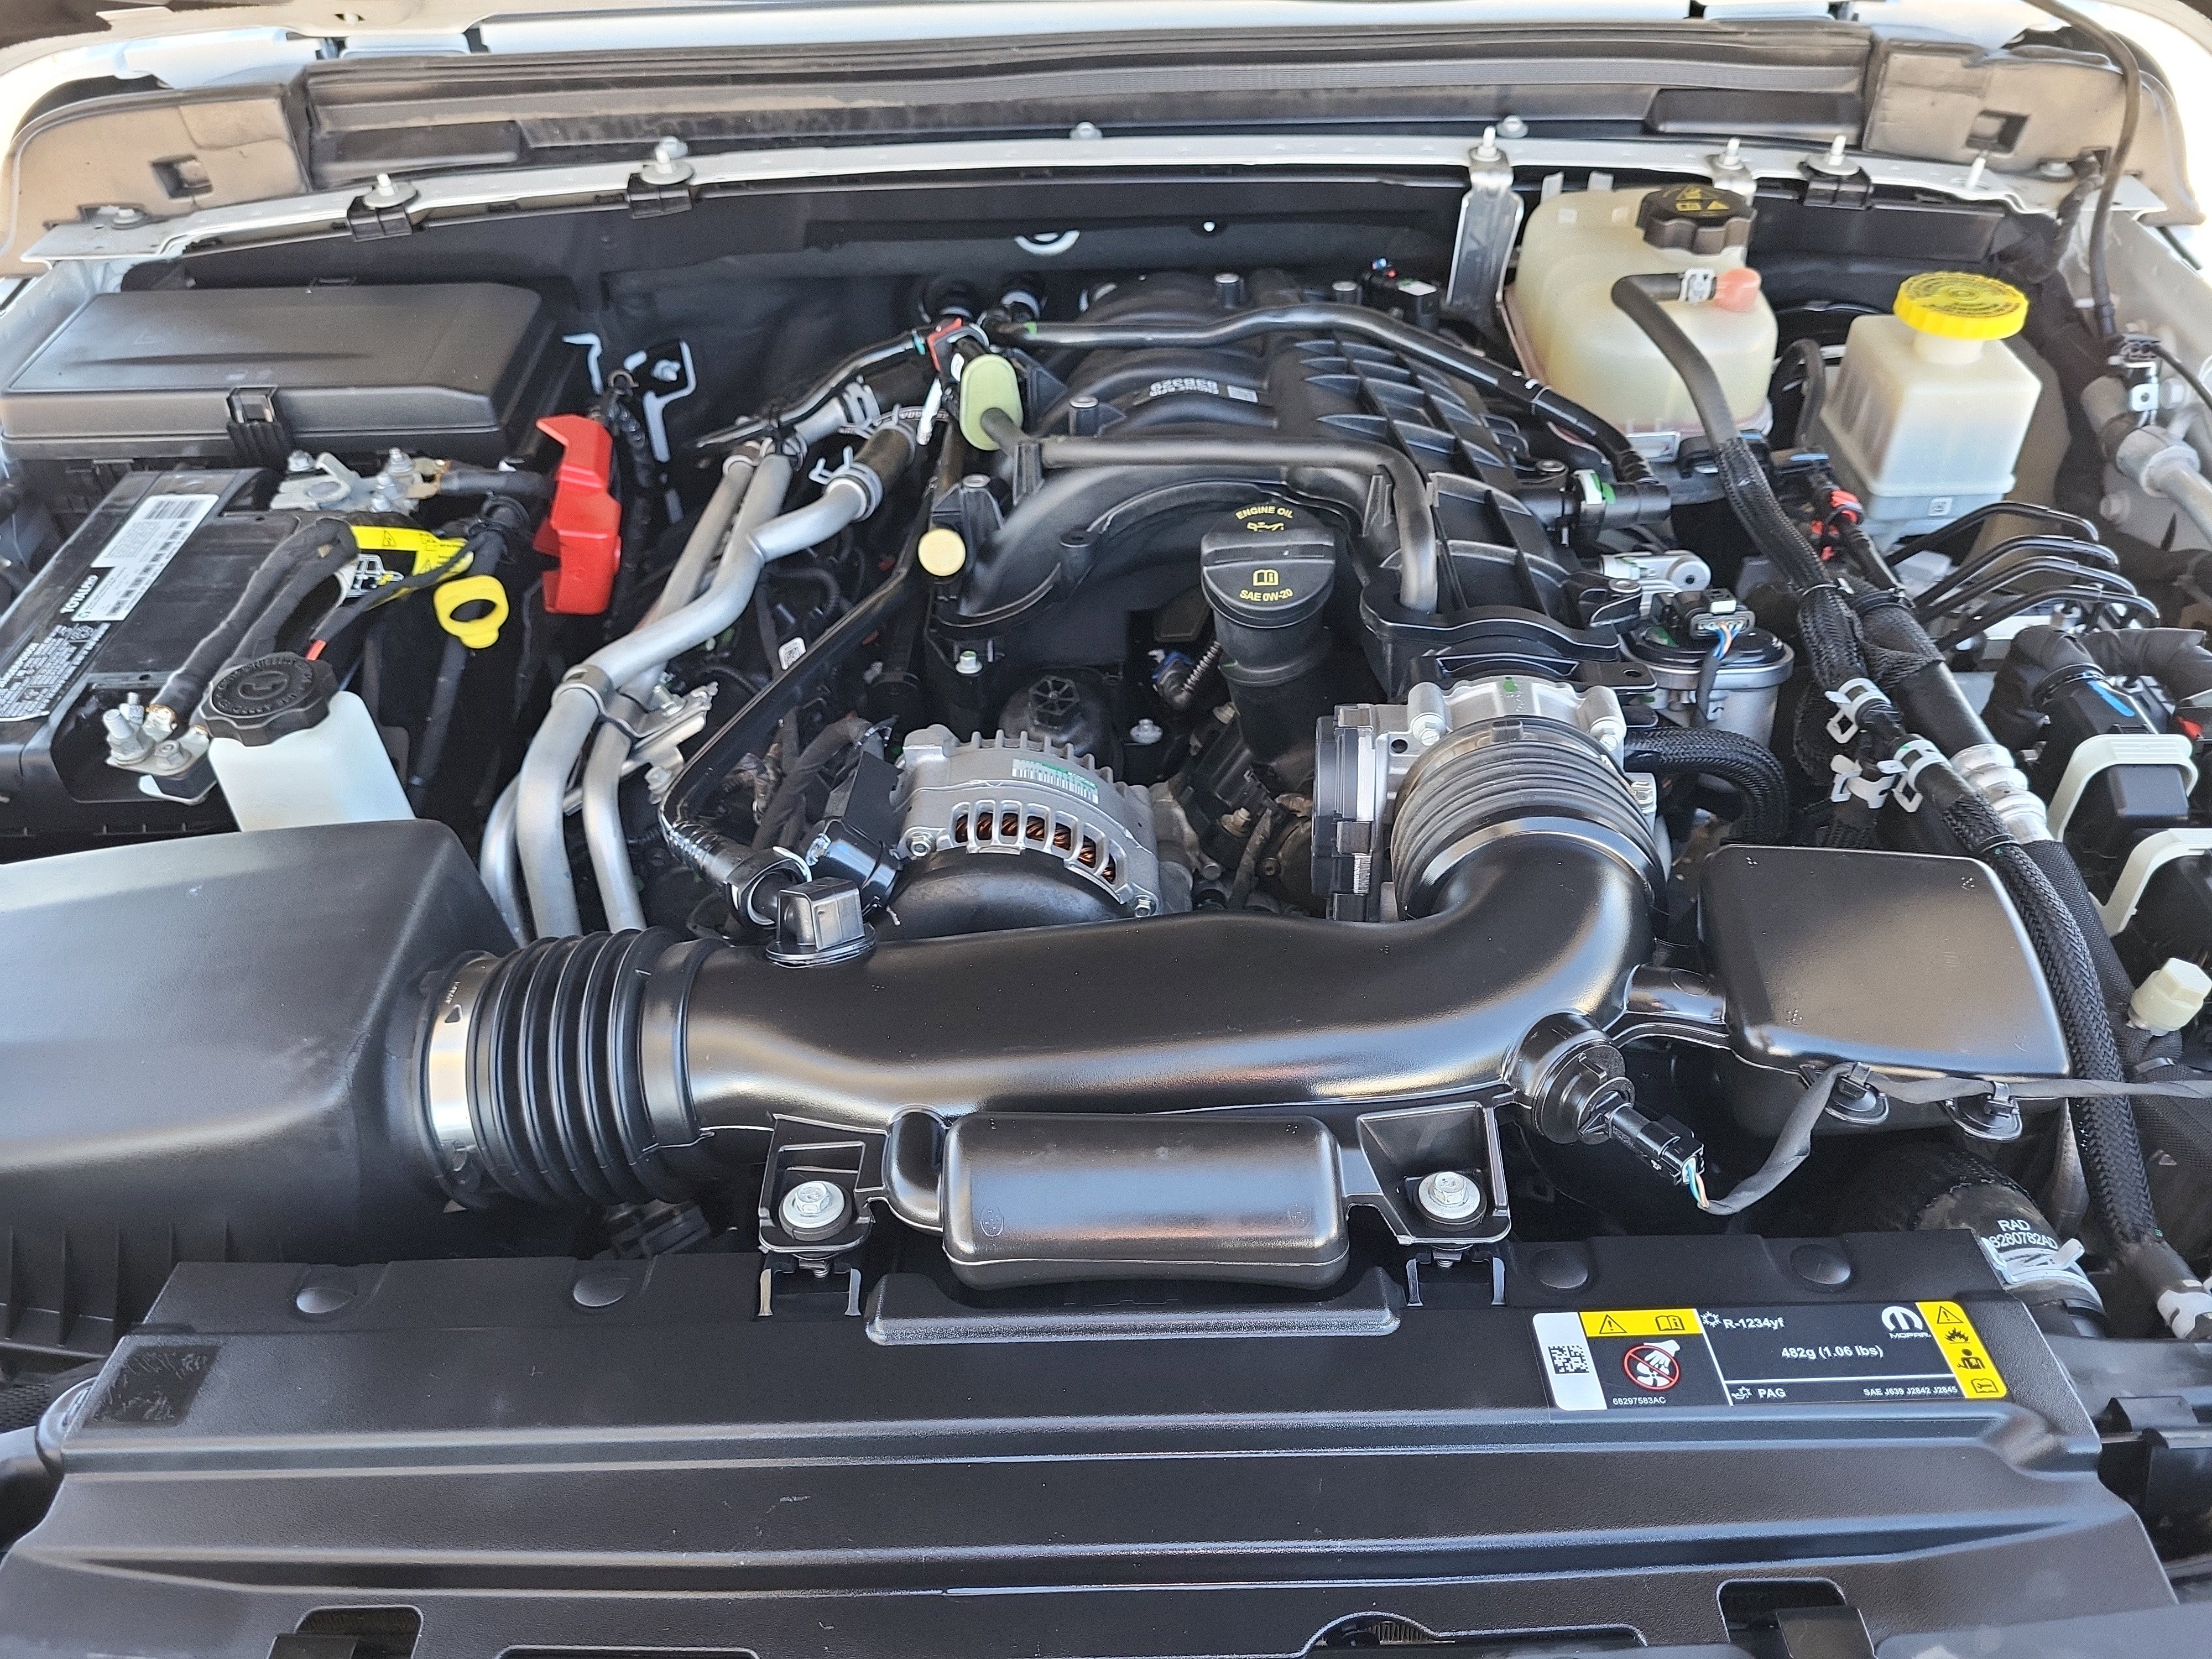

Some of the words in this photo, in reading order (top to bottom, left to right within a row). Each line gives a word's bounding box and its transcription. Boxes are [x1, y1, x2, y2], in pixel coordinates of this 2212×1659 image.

[1235, 505, 1276, 519] ENGINE
[1277, 508, 1293, 518] OIL
[1239, 589, 1261, 601] SAE
[1262, 588, 1293, 602] 0W-20
[1997, 1219, 2031, 1231] RAD
[1985, 1232, 2058, 1250] 8280782AD
[1723, 1317, 1785, 1331] R-1234yf
[1781, 1348, 1816, 1359] 482g
[1818, 1346, 1853, 1359] (1.06
[1854, 1345, 1884, 1358] lbs)
[1757, 1388, 1787, 1399] PAG
[1933, 1386, 1958, 1395] J2845
[1613, 1396, 1667, 1405] 68297583AC
